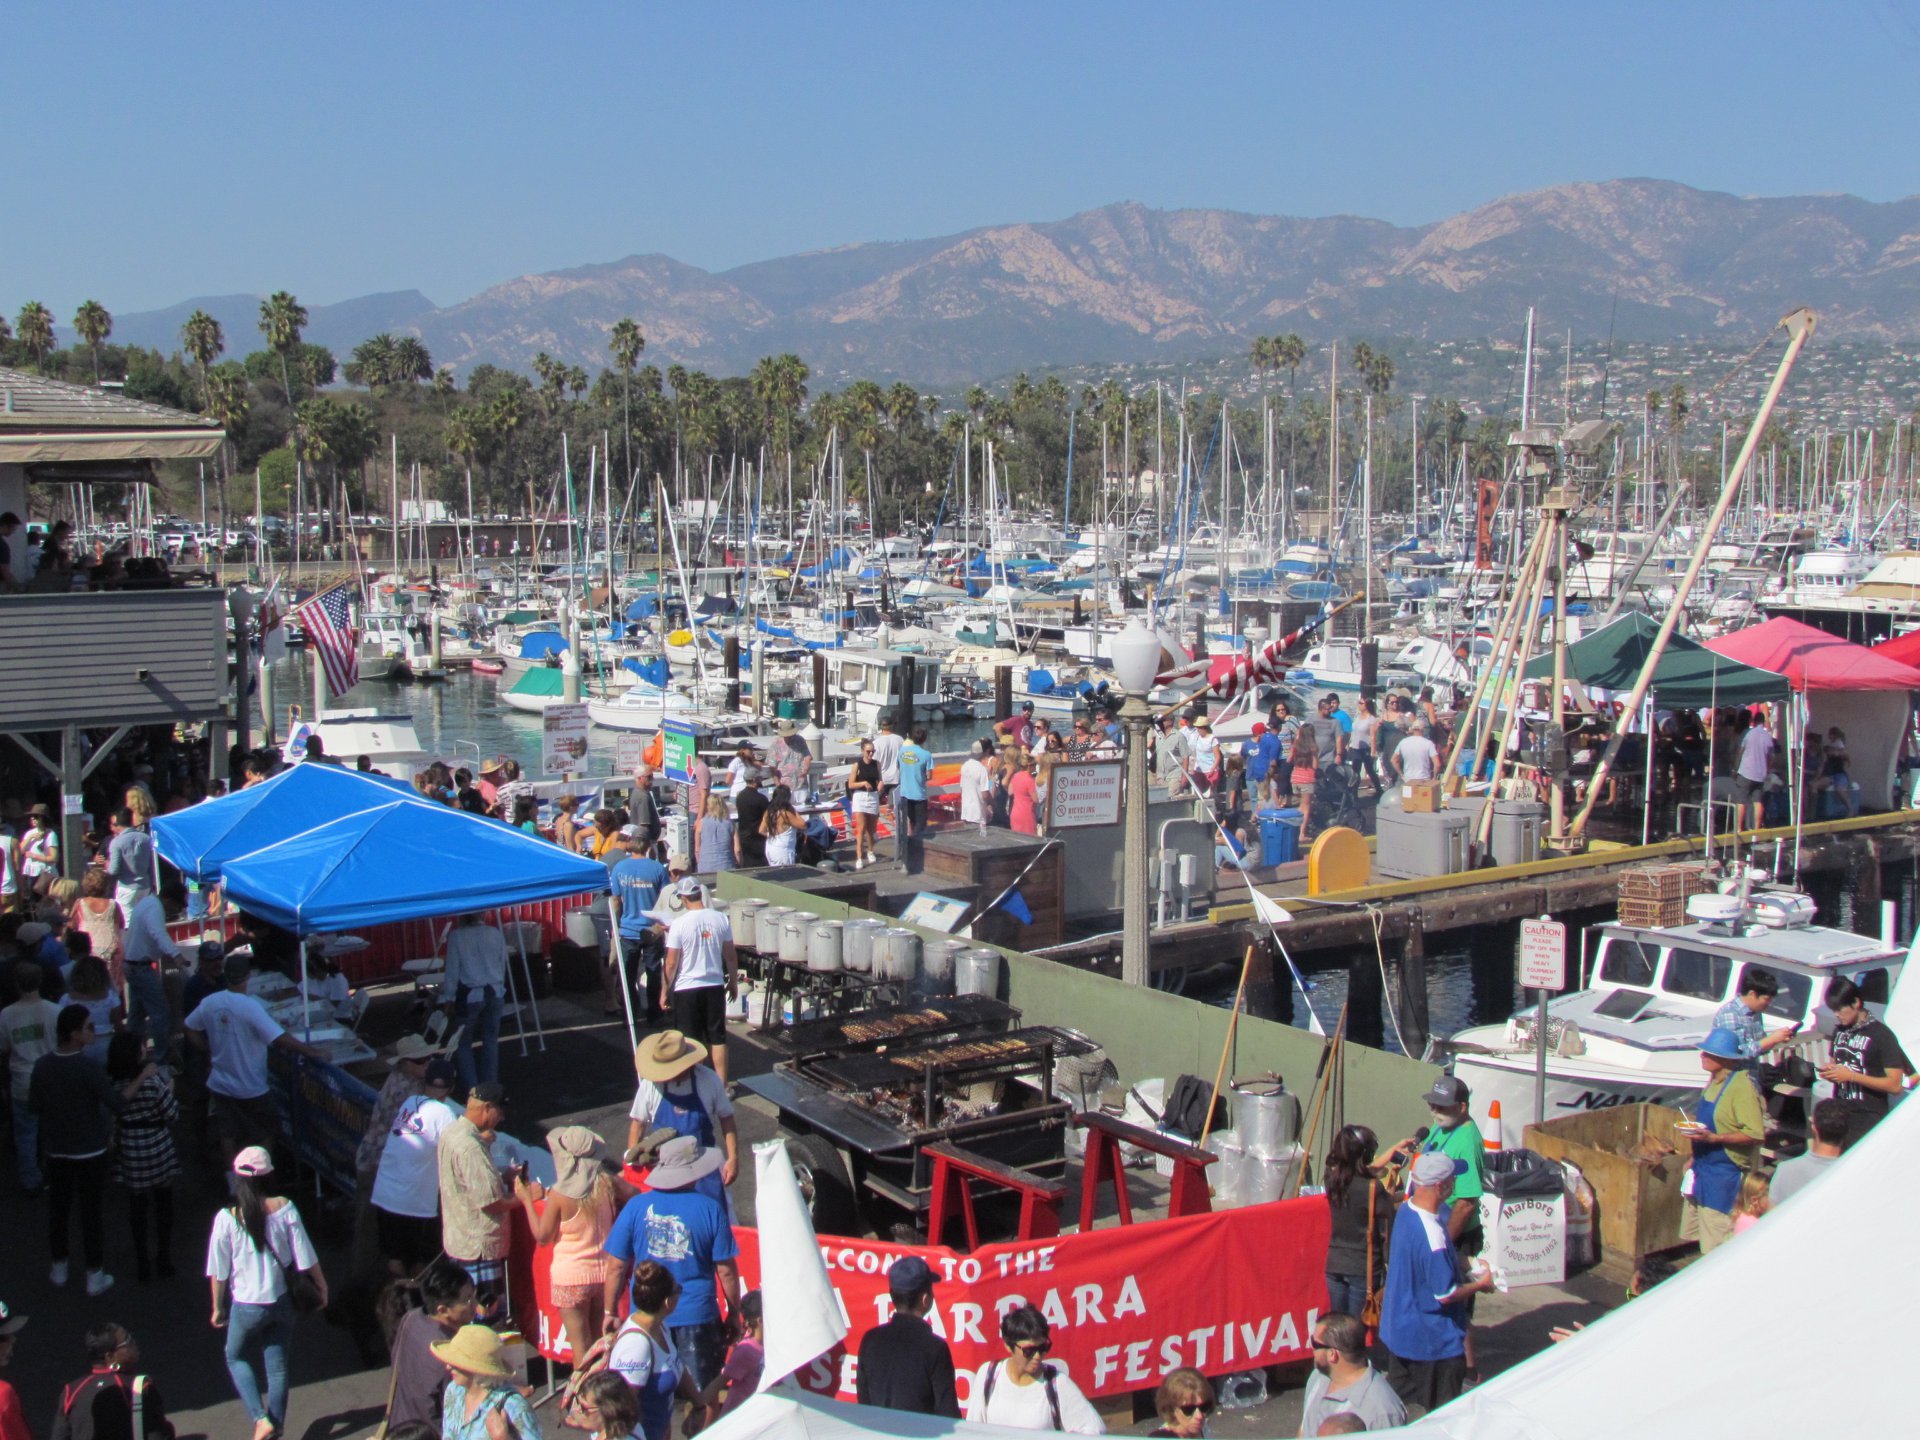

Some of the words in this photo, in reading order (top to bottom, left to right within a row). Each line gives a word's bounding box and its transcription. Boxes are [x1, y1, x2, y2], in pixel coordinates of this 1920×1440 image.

[1077, 769, 1095, 777] NO
[1069, 792, 1111, 800] SKATEBOARDING
[1068, 806, 1095, 814] BICYCLING
[1525, 927, 1560, 936] CAUTION
[1526, 967, 1556, 975] EQUIPMENT
[1503, 1199, 1553, 1219] MarBorg
[1507, 1224, 1527, 1233] Thank
[1530, 1222, 1542, 1231] You
[1544, 1222, 1553, 1230] for
[940, 1257, 981, 1283] TO
[995, 1246, 1056, 1276] THE
